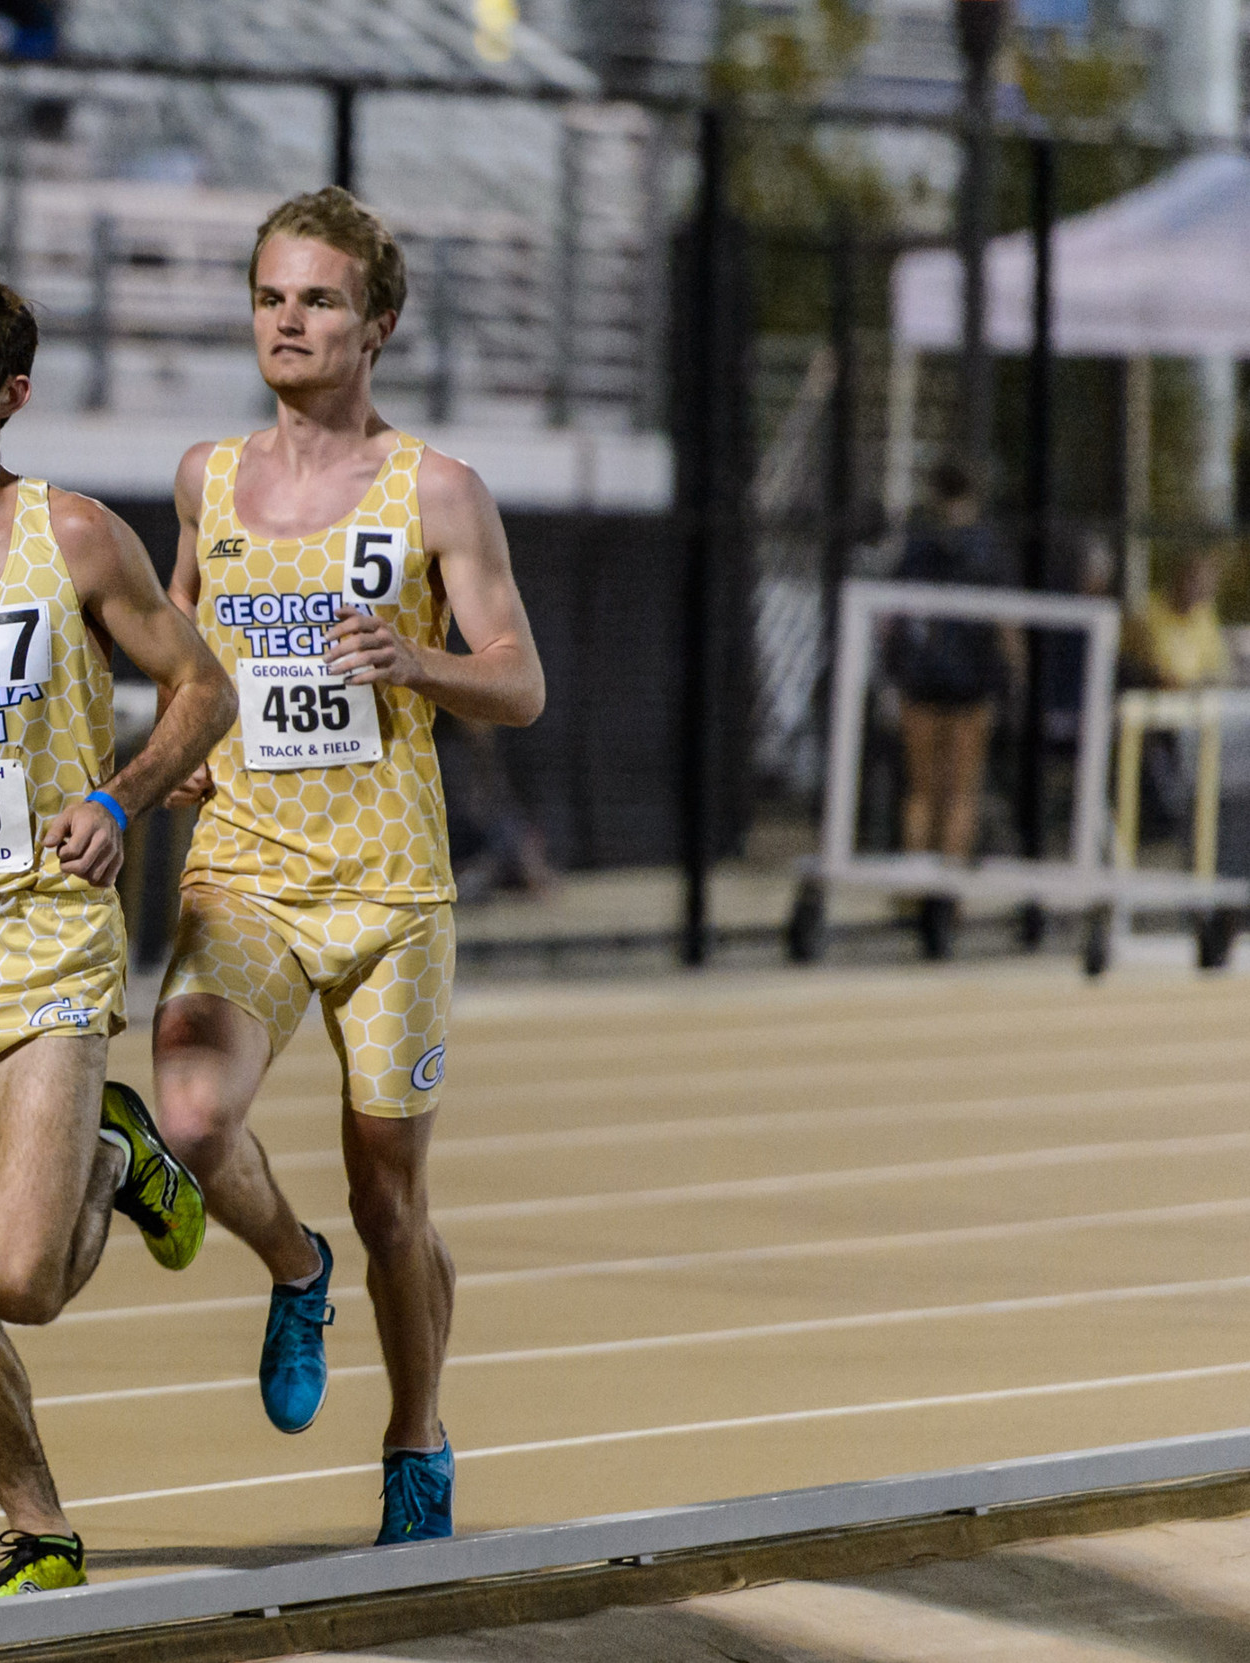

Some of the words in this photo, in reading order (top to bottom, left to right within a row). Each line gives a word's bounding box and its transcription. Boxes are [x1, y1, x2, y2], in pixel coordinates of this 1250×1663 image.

[210, 539, 245, 555] ACC
[351, 532, 393, 599] 5
[252, 665, 314, 677] GEORGIA
[263, 684, 350, 733] 435
[260, 745, 303, 757] TRACK
[308, 744, 318, 755] &
[324, 740, 360, 754] FIELD
